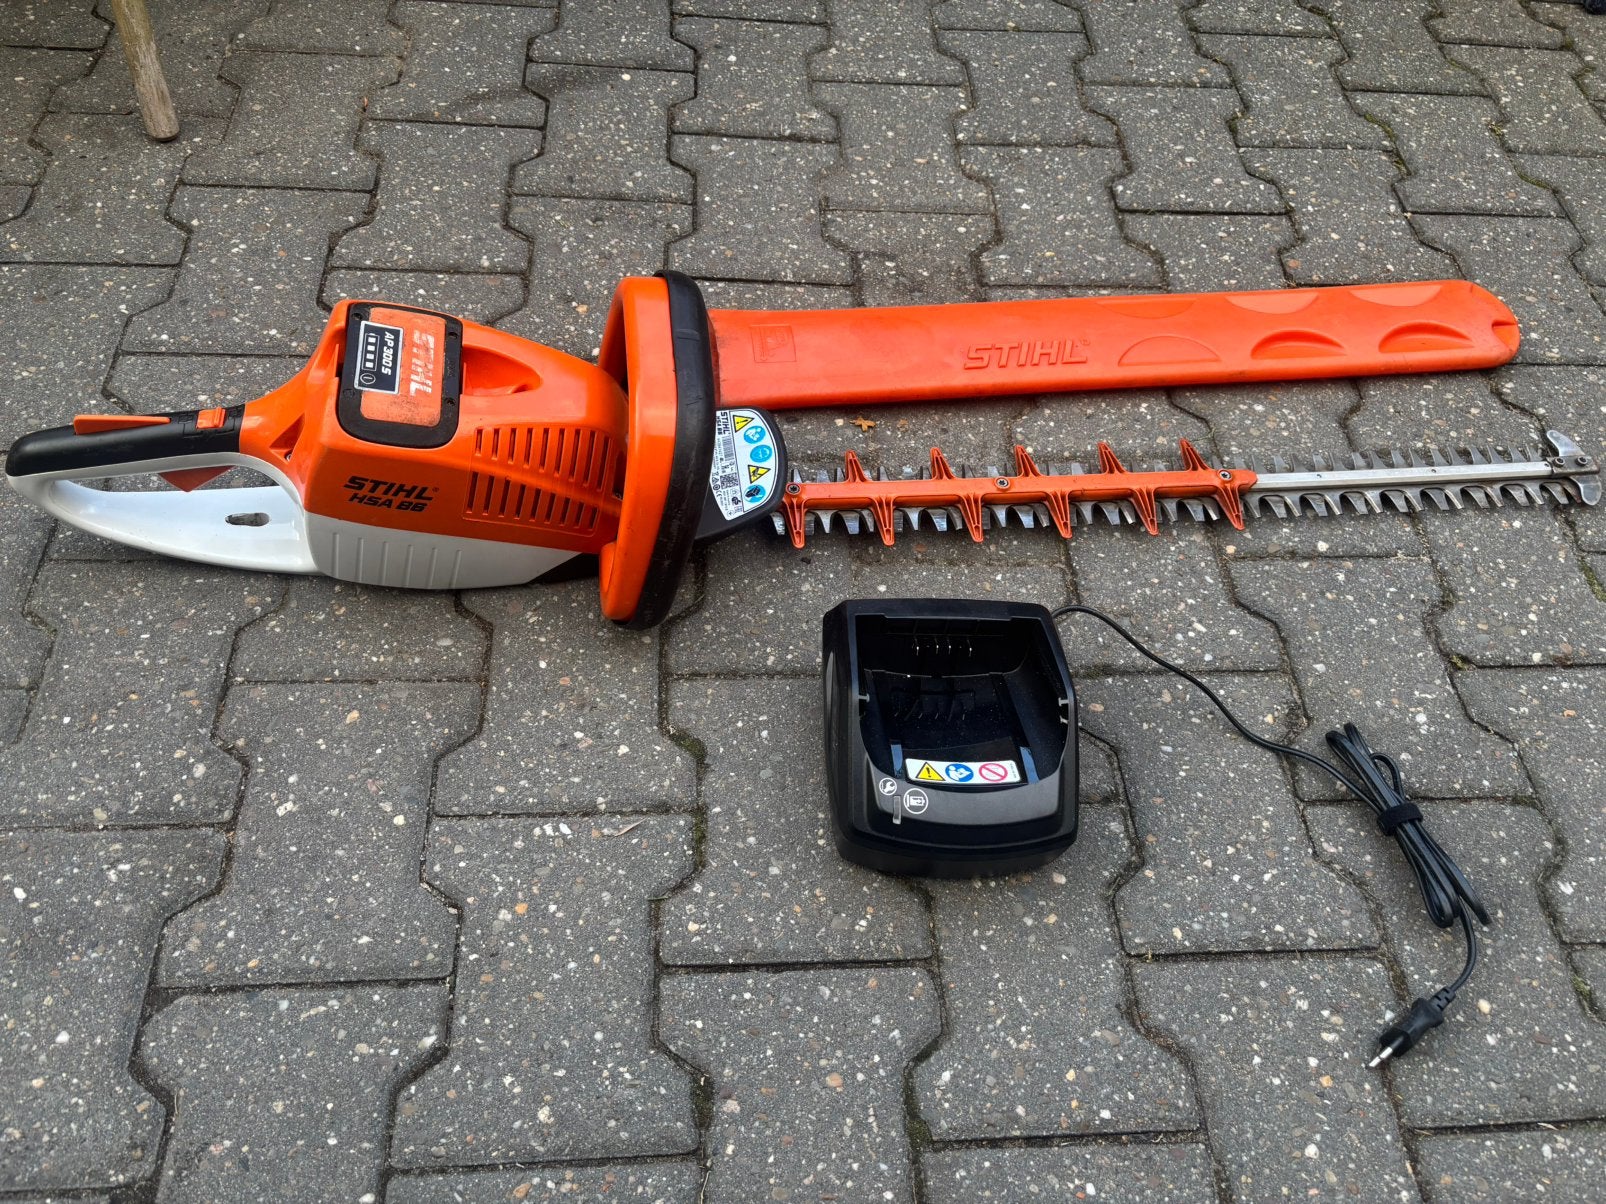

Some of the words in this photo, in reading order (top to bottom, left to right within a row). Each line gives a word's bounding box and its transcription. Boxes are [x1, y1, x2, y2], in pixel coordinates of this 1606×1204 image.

[384, 331, 395, 346] AP
[382, 346, 394, 366] 300
[410, 329, 435, 397] STIHL
[963, 339, 1088, 370] STIHL
[381, 366, 392, 376] S
[720, 411, 730, 435] STIHL
[343, 475, 434, 501] STIHL
[348, 492, 394, 509] HSA
[396, 500, 428, 512] 86
